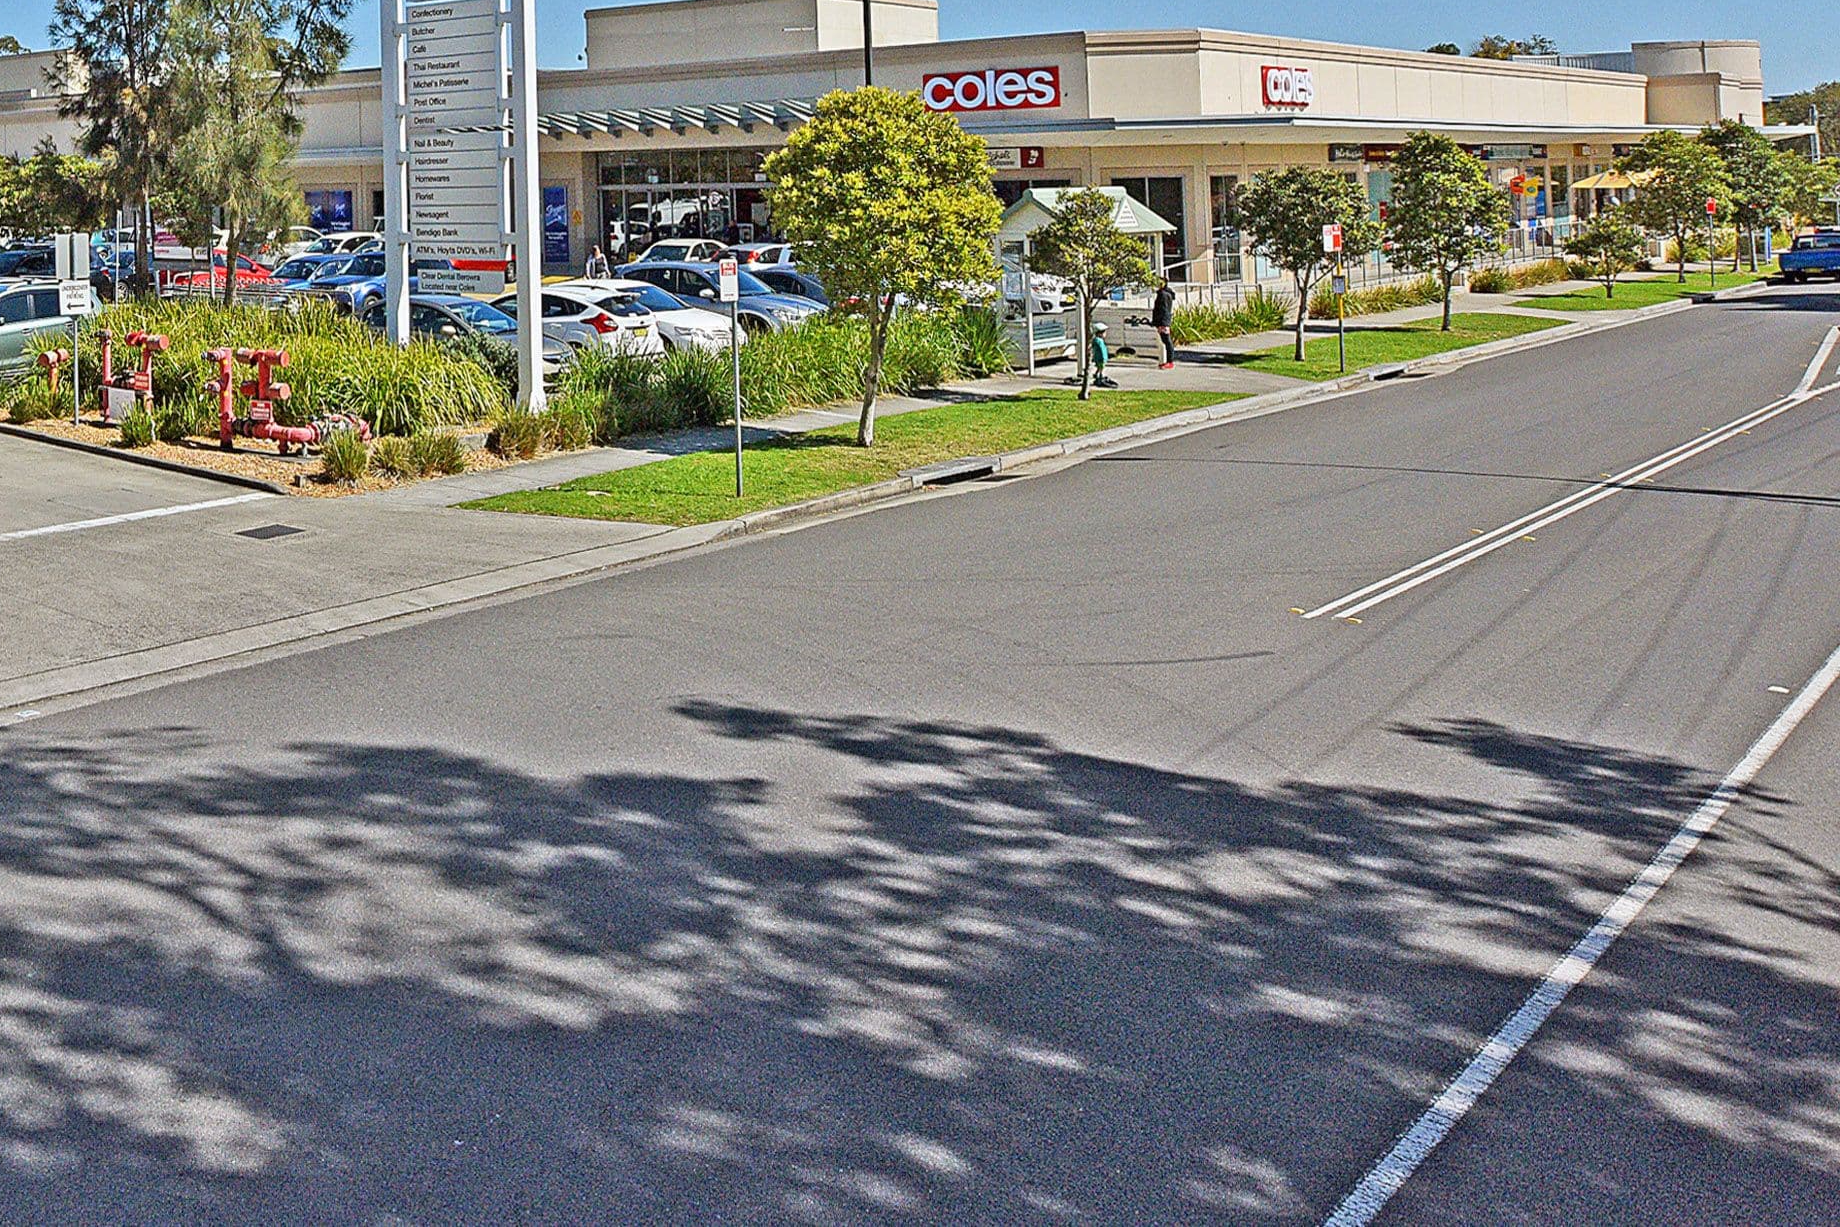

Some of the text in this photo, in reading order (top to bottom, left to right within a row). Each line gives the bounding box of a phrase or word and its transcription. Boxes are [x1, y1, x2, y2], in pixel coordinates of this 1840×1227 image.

[411, 7, 453, 19] Confectionery
[411, 27, 435, 36] Butcher
[413, 60, 460, 71] Thai Restaurant
[413, 77, 469, 89] Michel's Patisserie
[1267, 68, 1314, 103] coles
[923, 70, 1055, 110] coles
[414, 96, 446, 106] Post Office
[414, 116, 435, 124] Dentist
[414, 138, 454, 148] Nail & Beauty
[415, 157, 448, 165] Hairdresser
[415, 174, 450, 183] Homewares
[415, 192, 434, 201] Florist
[416, 210, 449, 220] Newsagent
[416, 228, 441, 237] Bendigo
[437, 246, 455, 255] Hoyts
[437, 273, 455, 281] Dental
[421, 283, 444, 291] Located
